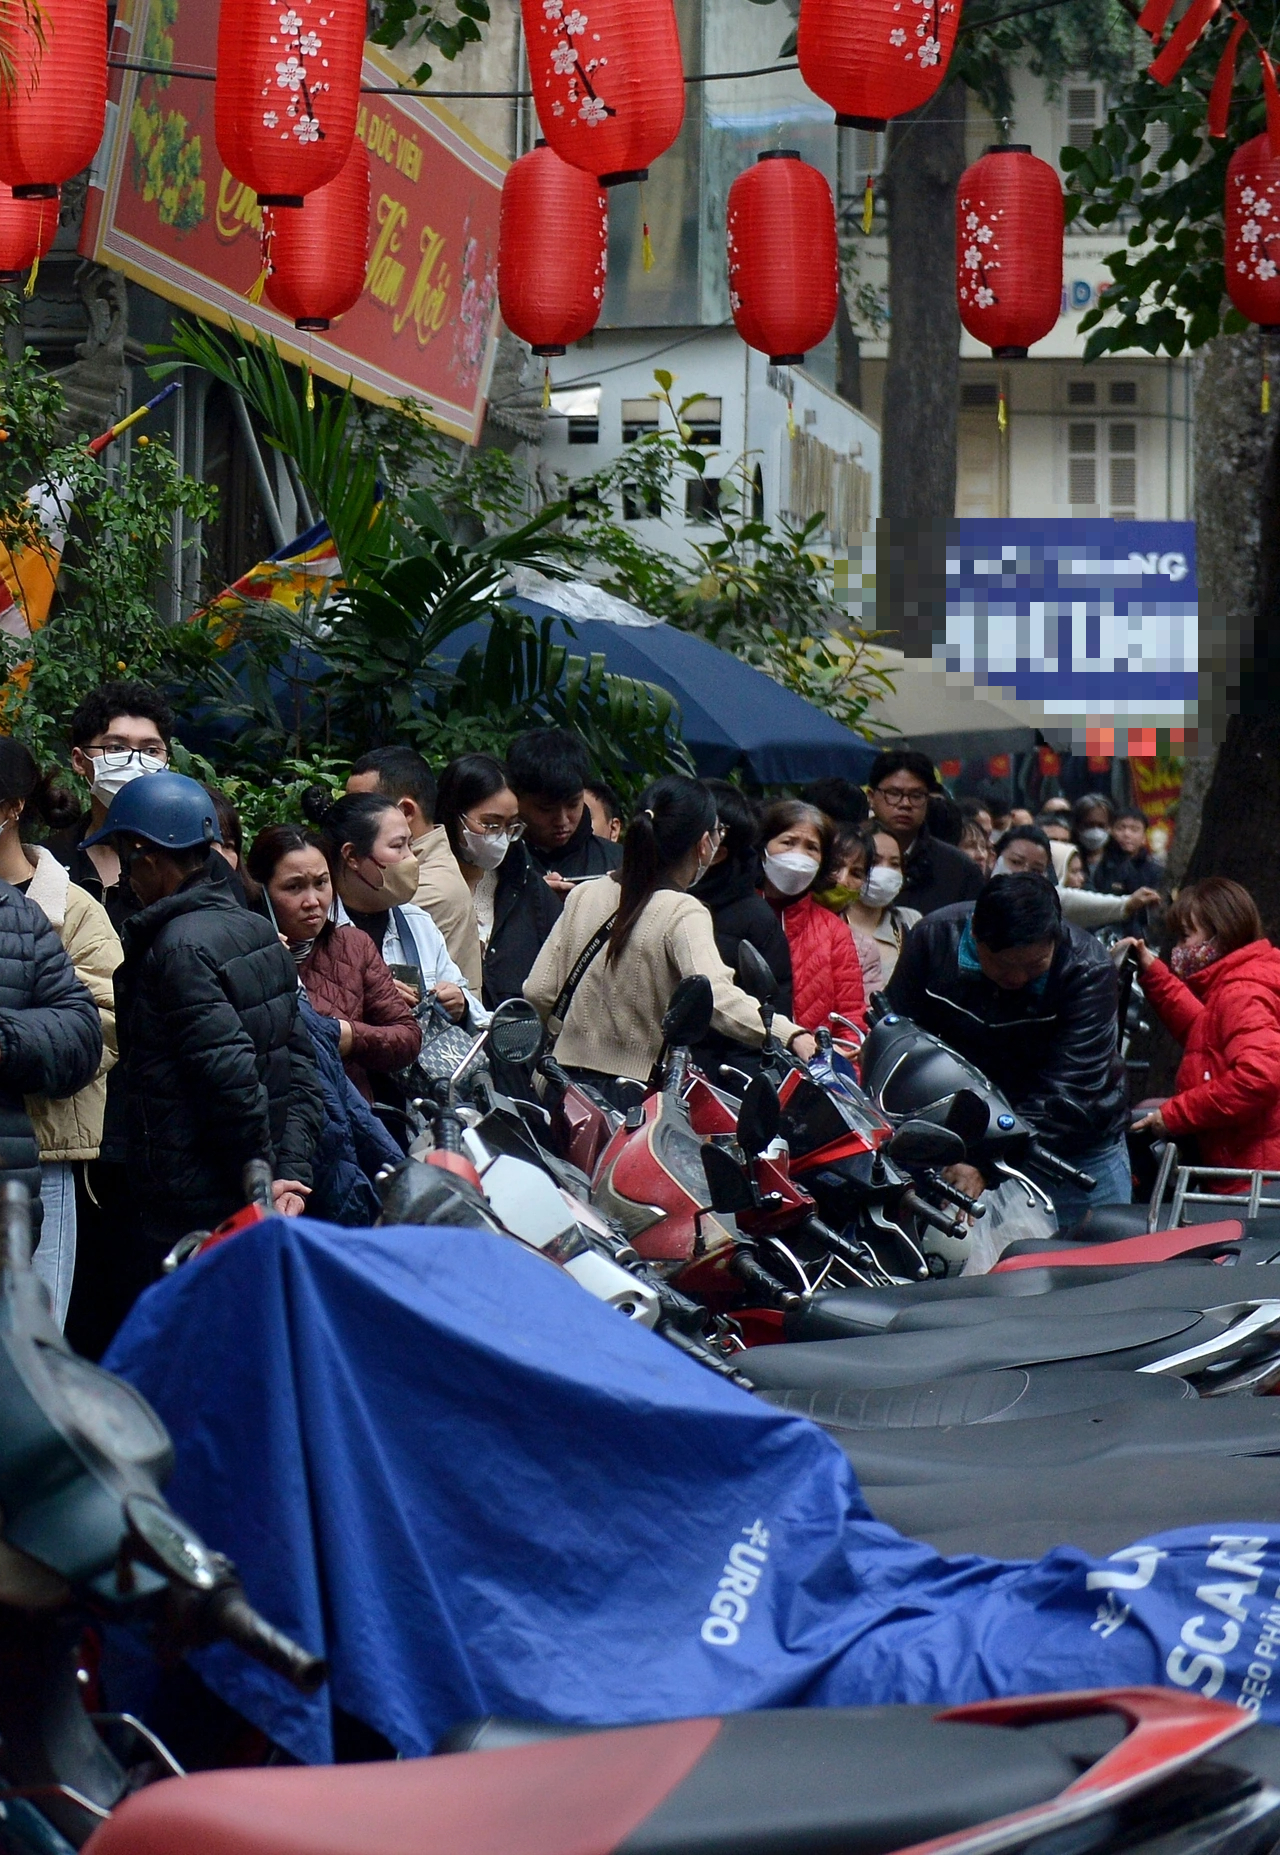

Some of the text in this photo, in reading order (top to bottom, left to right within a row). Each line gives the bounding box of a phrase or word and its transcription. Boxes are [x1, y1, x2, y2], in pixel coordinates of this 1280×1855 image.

[367, 112, 396, 164] ĐỨC
[701, 1541, 768, 1646] URGO
[1236, 1661, 1272, 1713] SẸO
